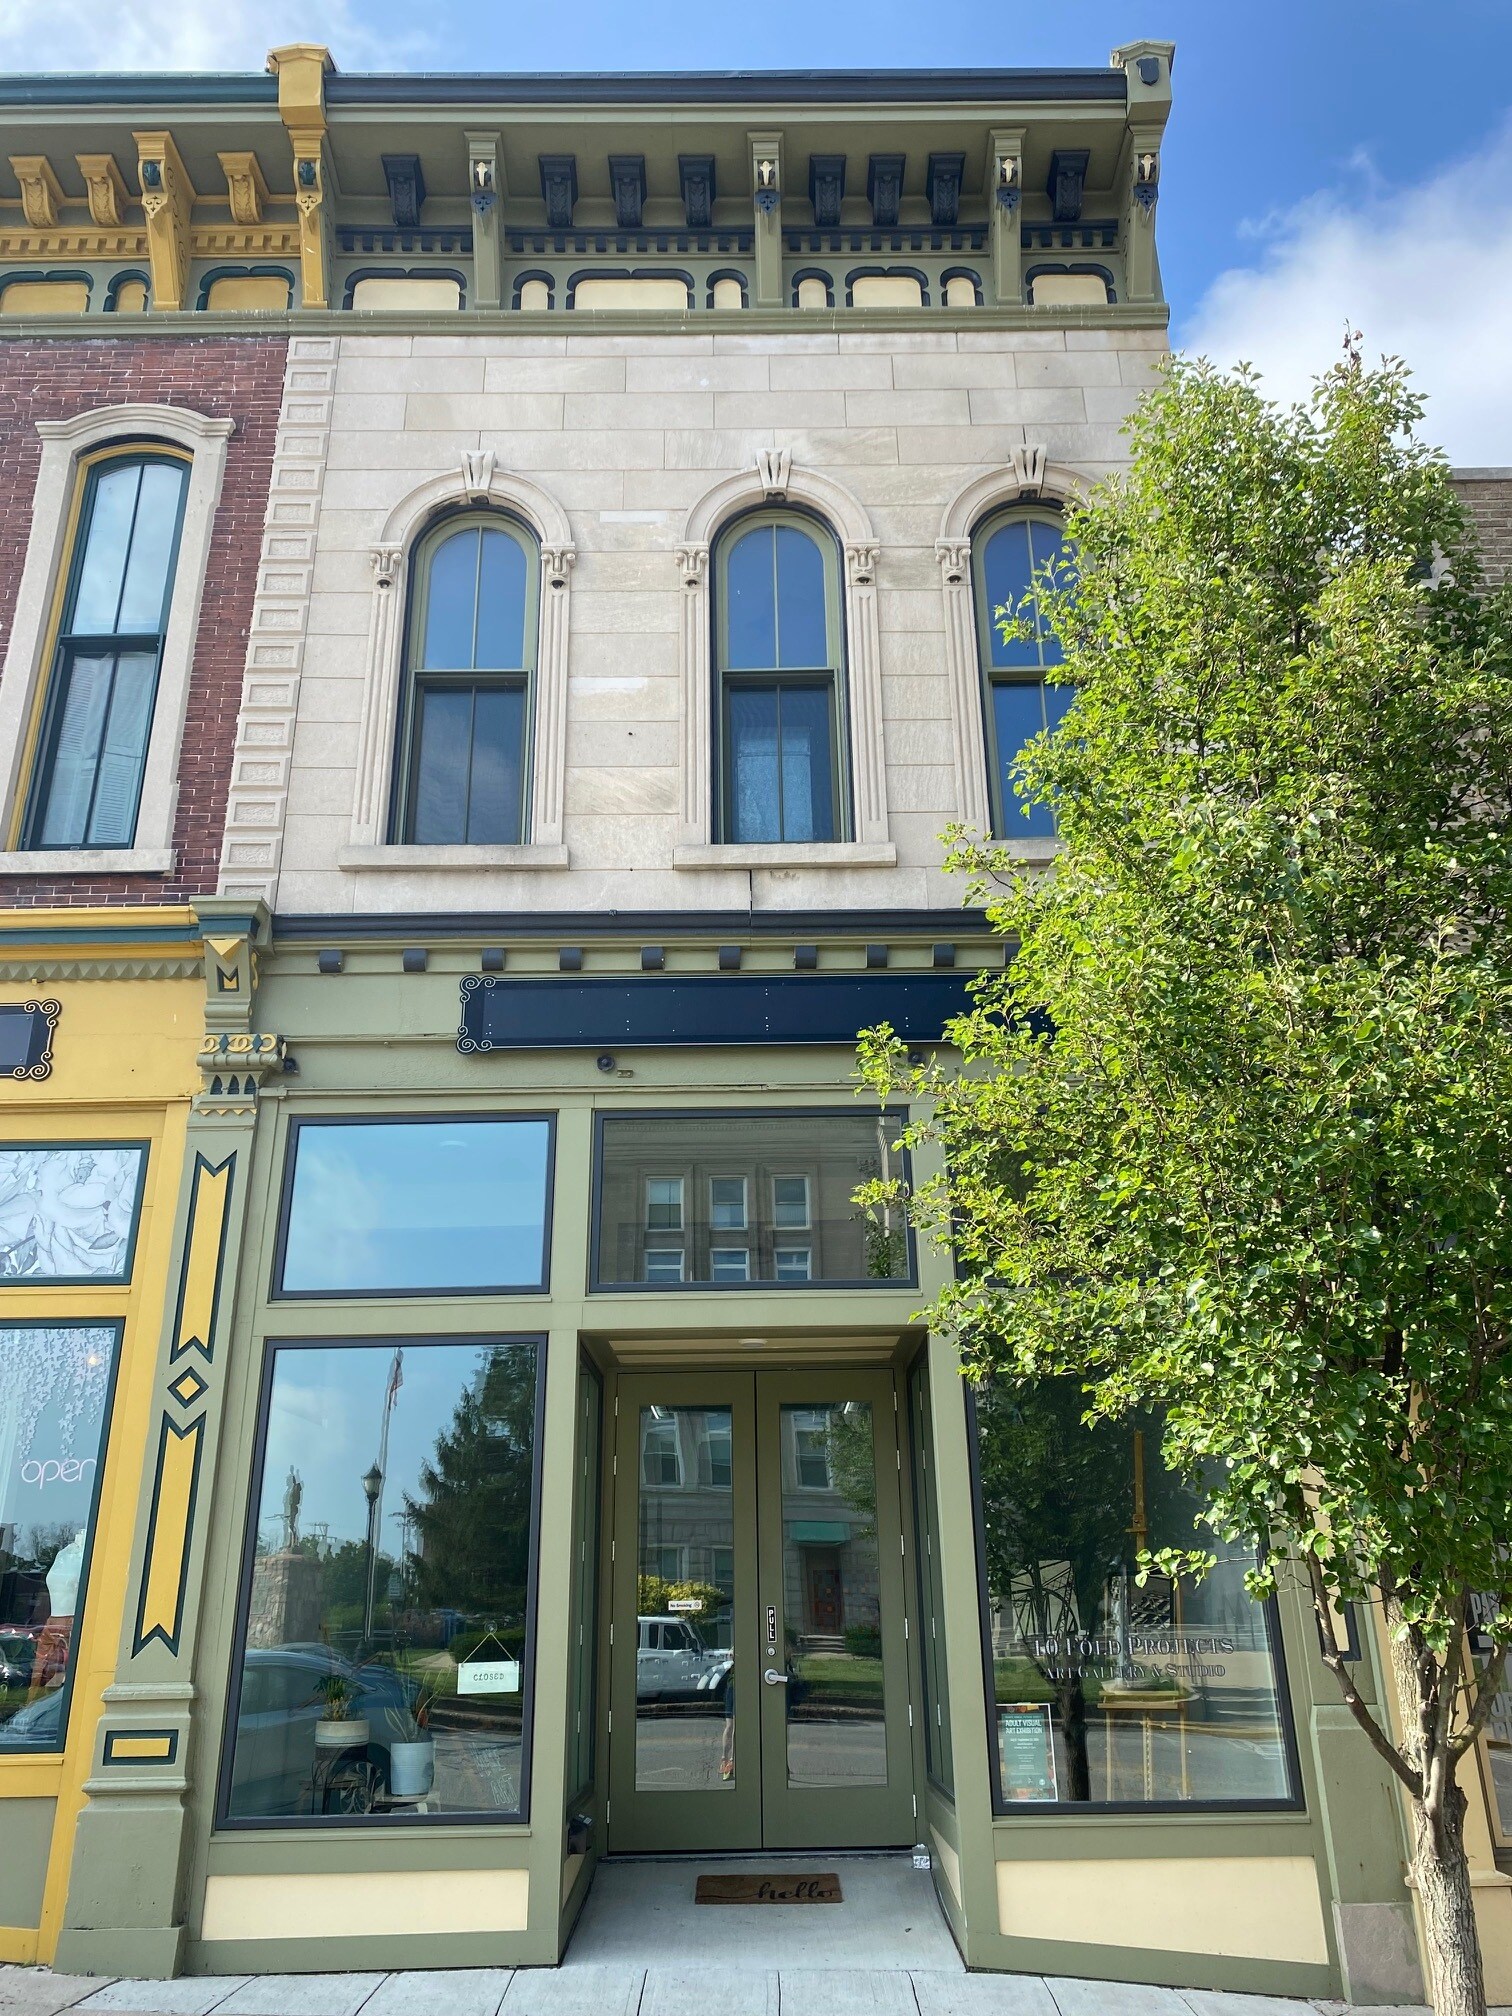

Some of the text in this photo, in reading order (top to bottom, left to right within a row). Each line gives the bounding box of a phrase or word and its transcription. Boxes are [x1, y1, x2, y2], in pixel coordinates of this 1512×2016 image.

[1127, 1635, 1235, 1656] PROJECTS
[1164, 1662, 1226, 1678] STUDIO
[473, 1672, 505, 1682] CLOSED
[1005, 1719, 1042, 1727] ADULT VISUAL
[1005, 1727, 1016, 1735] ART
[757, 1881, 834, 1899] hello
